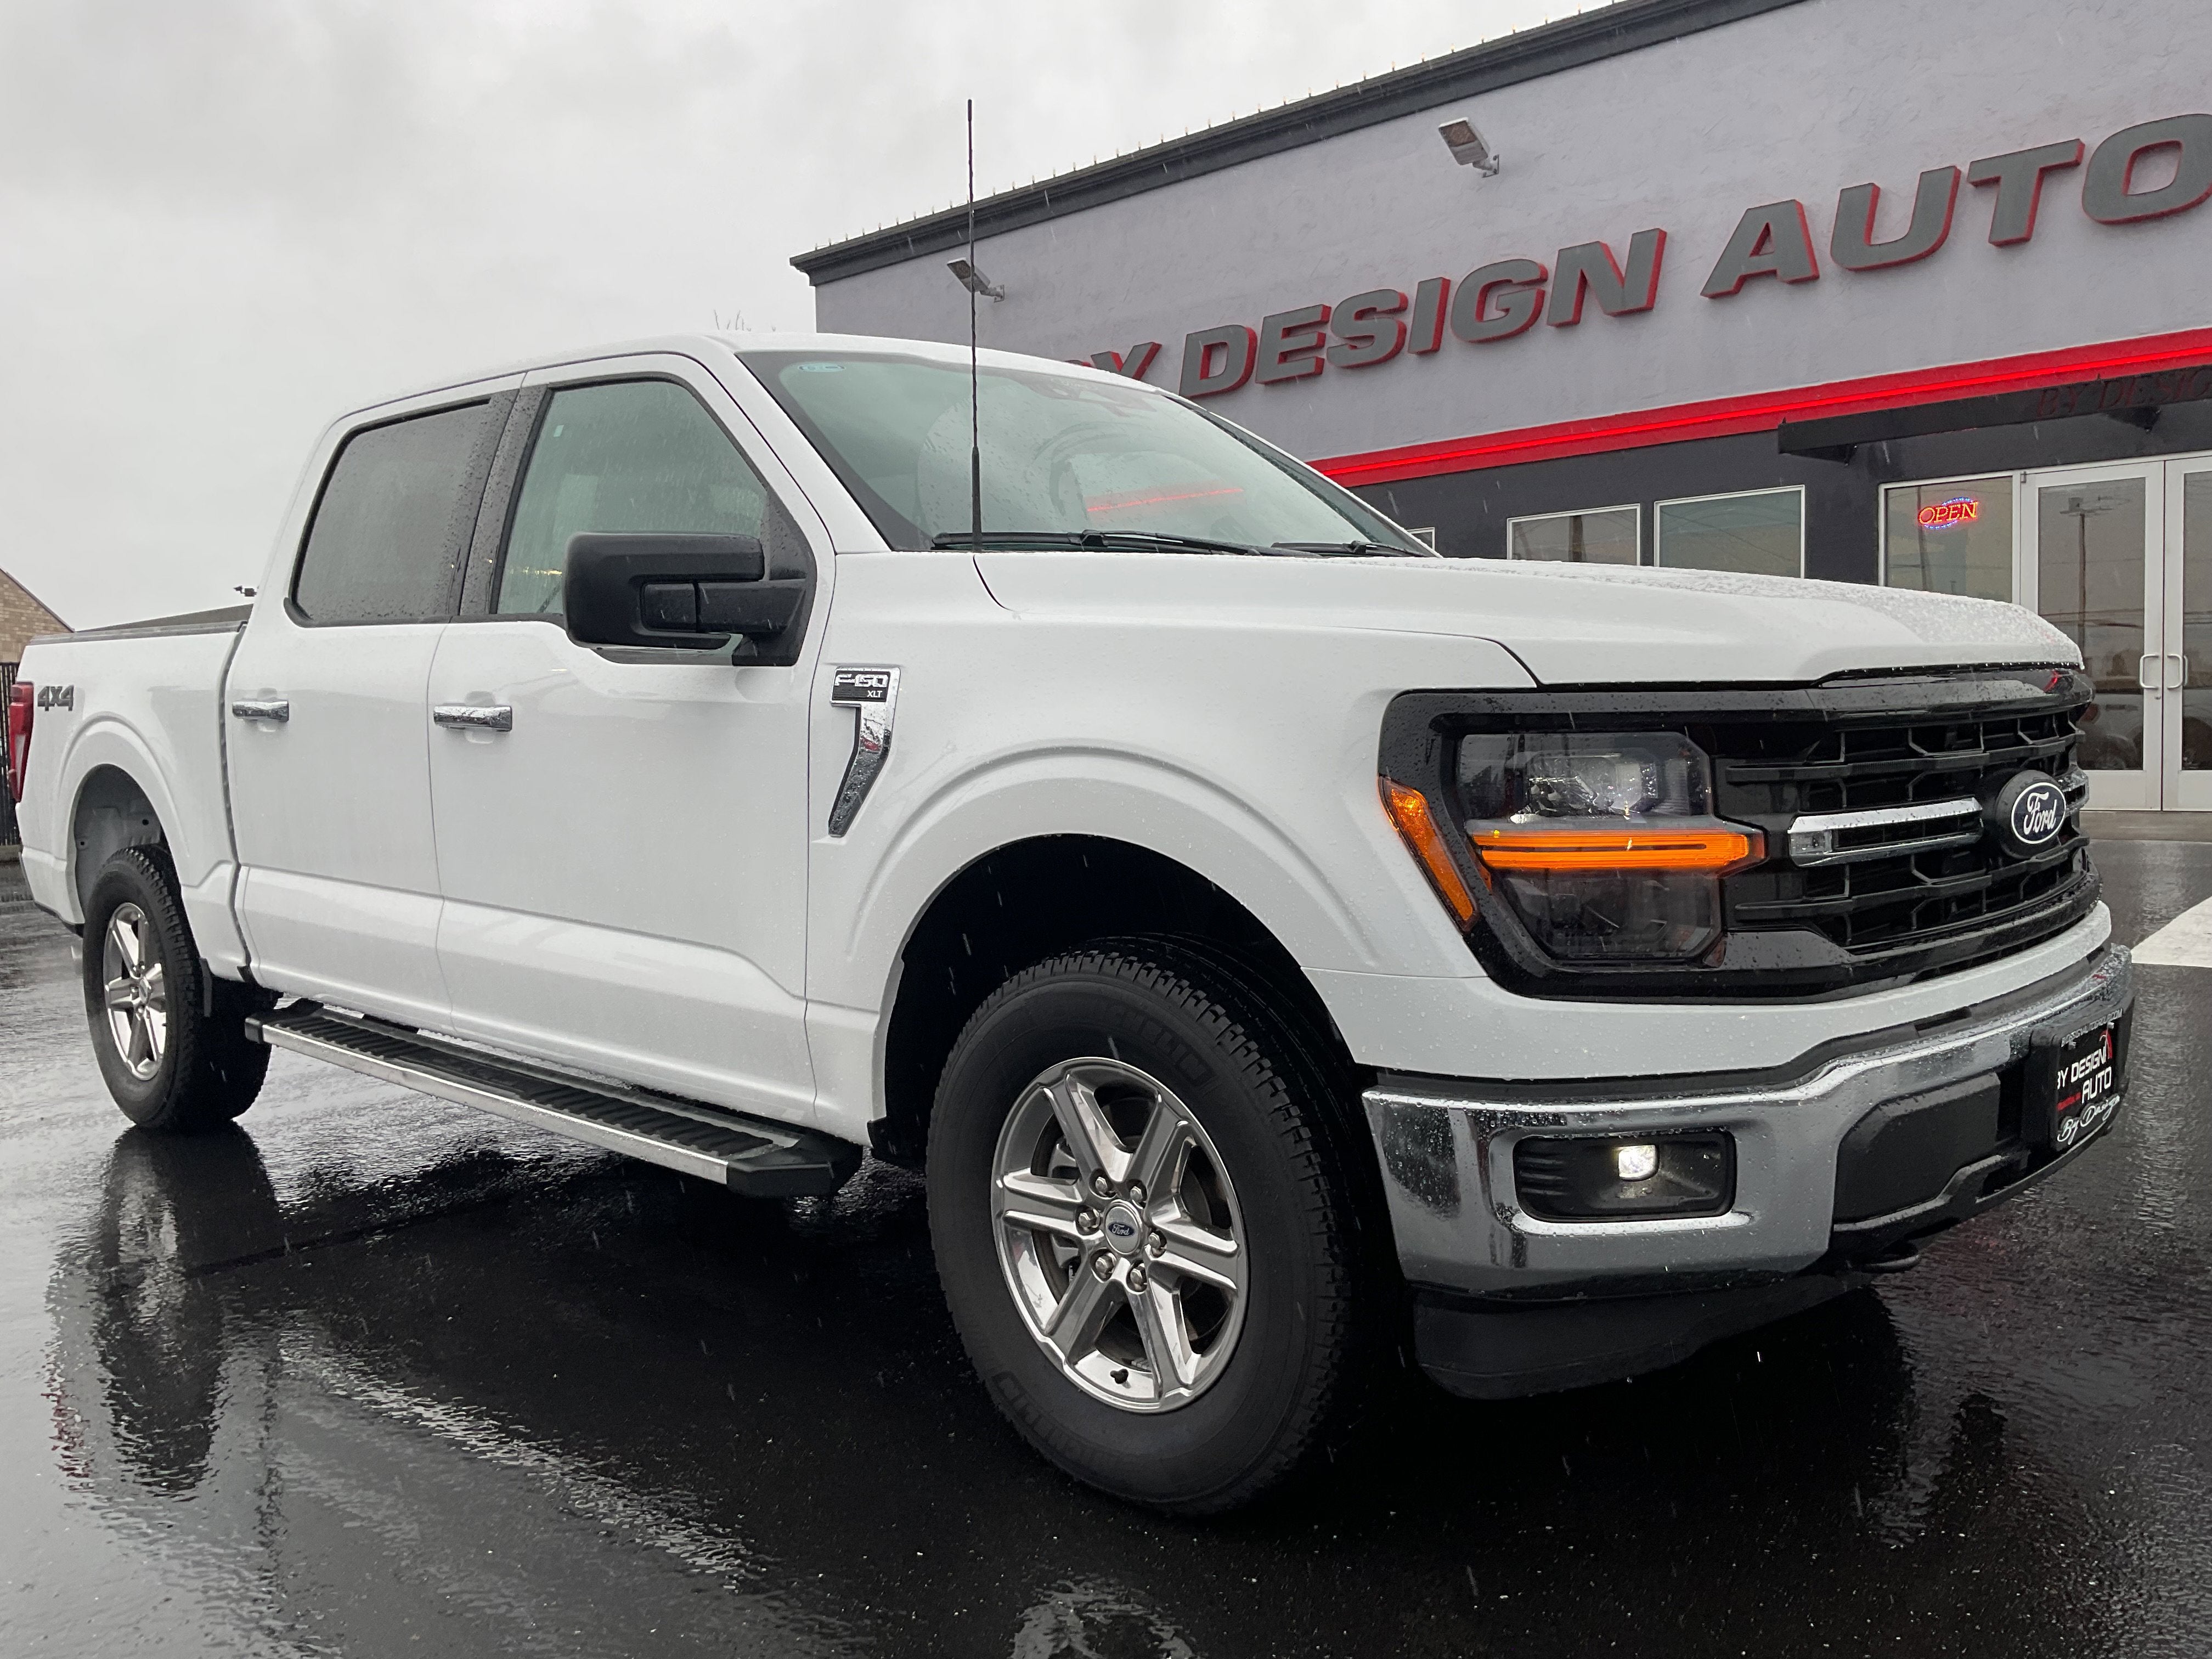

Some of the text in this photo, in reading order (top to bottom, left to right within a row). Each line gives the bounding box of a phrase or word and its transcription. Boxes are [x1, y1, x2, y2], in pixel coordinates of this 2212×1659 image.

[1065, 114, 2212, 398] Y DESIGN AUTO
[1918, 500, 1978, 524] OPEN
[834, 673, 888, 688] F-150
[2023, 792, 2057, 835] Ford
[2070, 1046, 2107, 1083] DESIGN
[2082, 1066, 2112, 1104] AUTO
[2057, 1094, 2120, 1146] By Design
[1111, 1223, 1130, 1236] Ford
